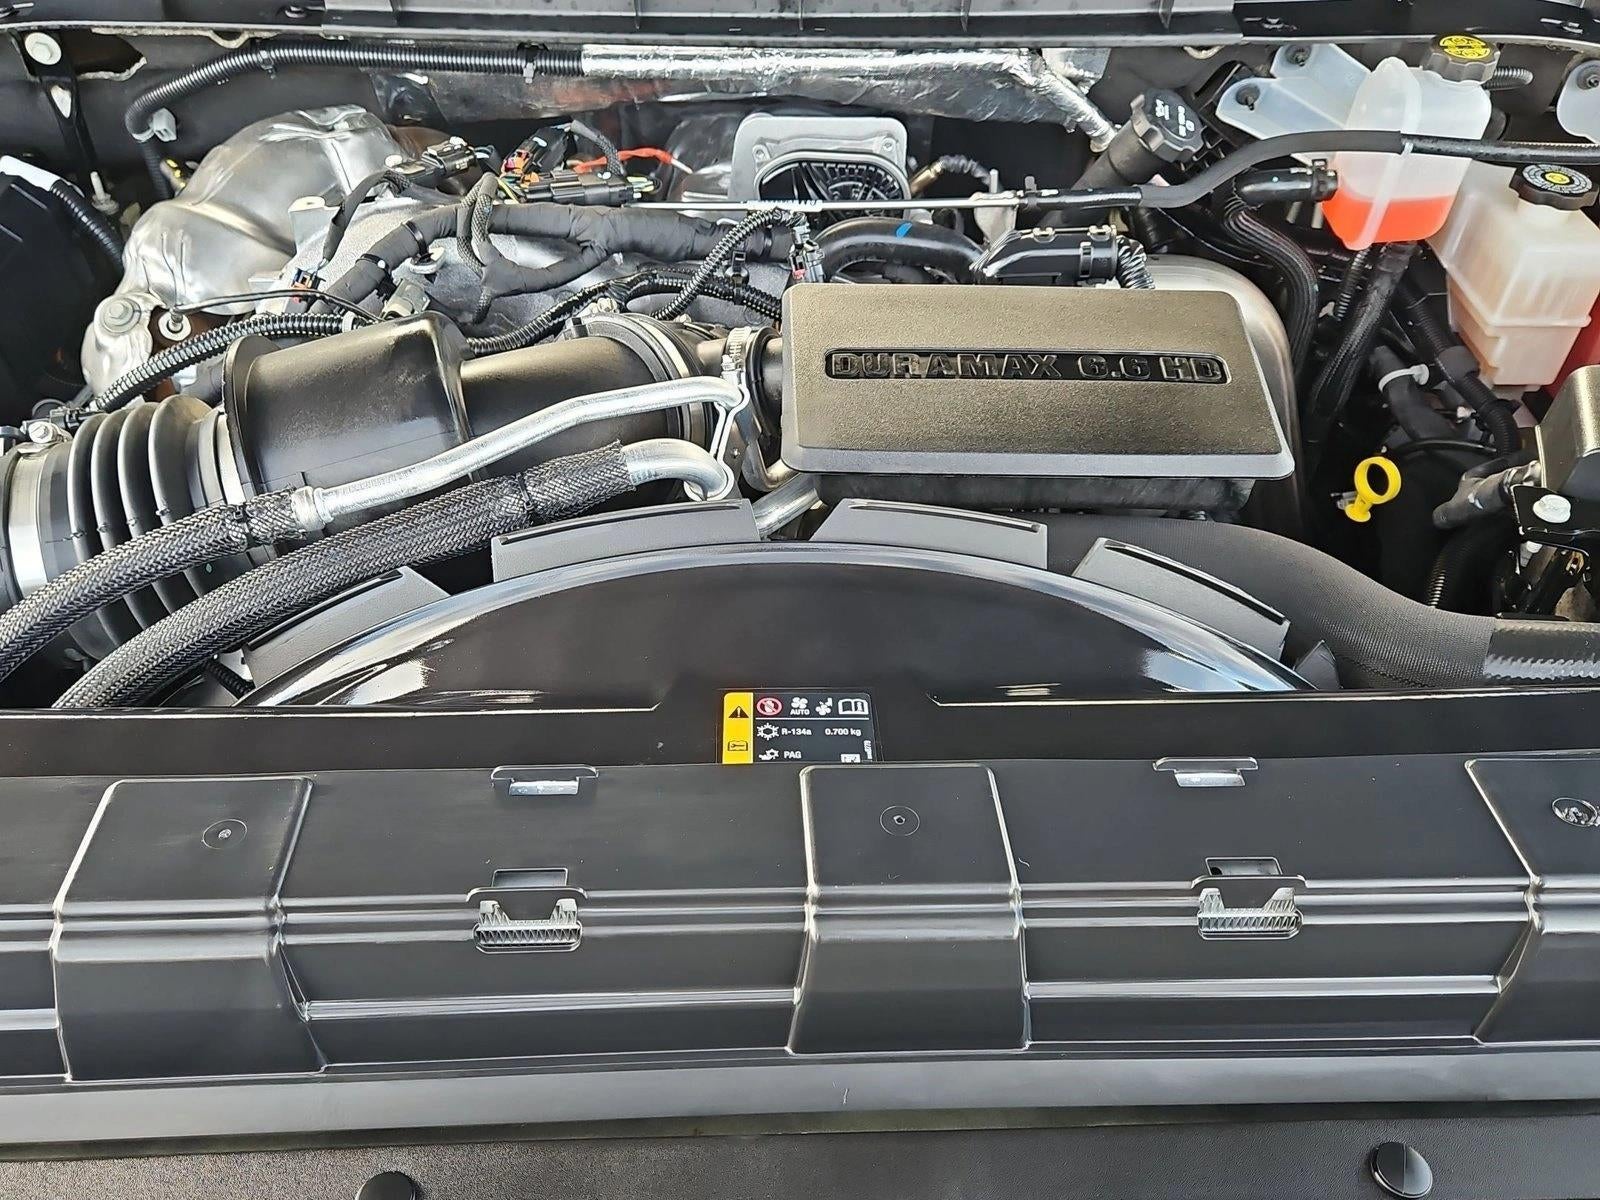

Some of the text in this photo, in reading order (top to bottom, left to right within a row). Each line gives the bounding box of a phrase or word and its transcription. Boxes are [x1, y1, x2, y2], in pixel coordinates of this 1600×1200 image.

[832, 353, 1222, 381] DURAMAX 6.6 HD
[782, 728, 862, 737] R-134a 0.700 kg
[784, 751, 802, 759] PAG
